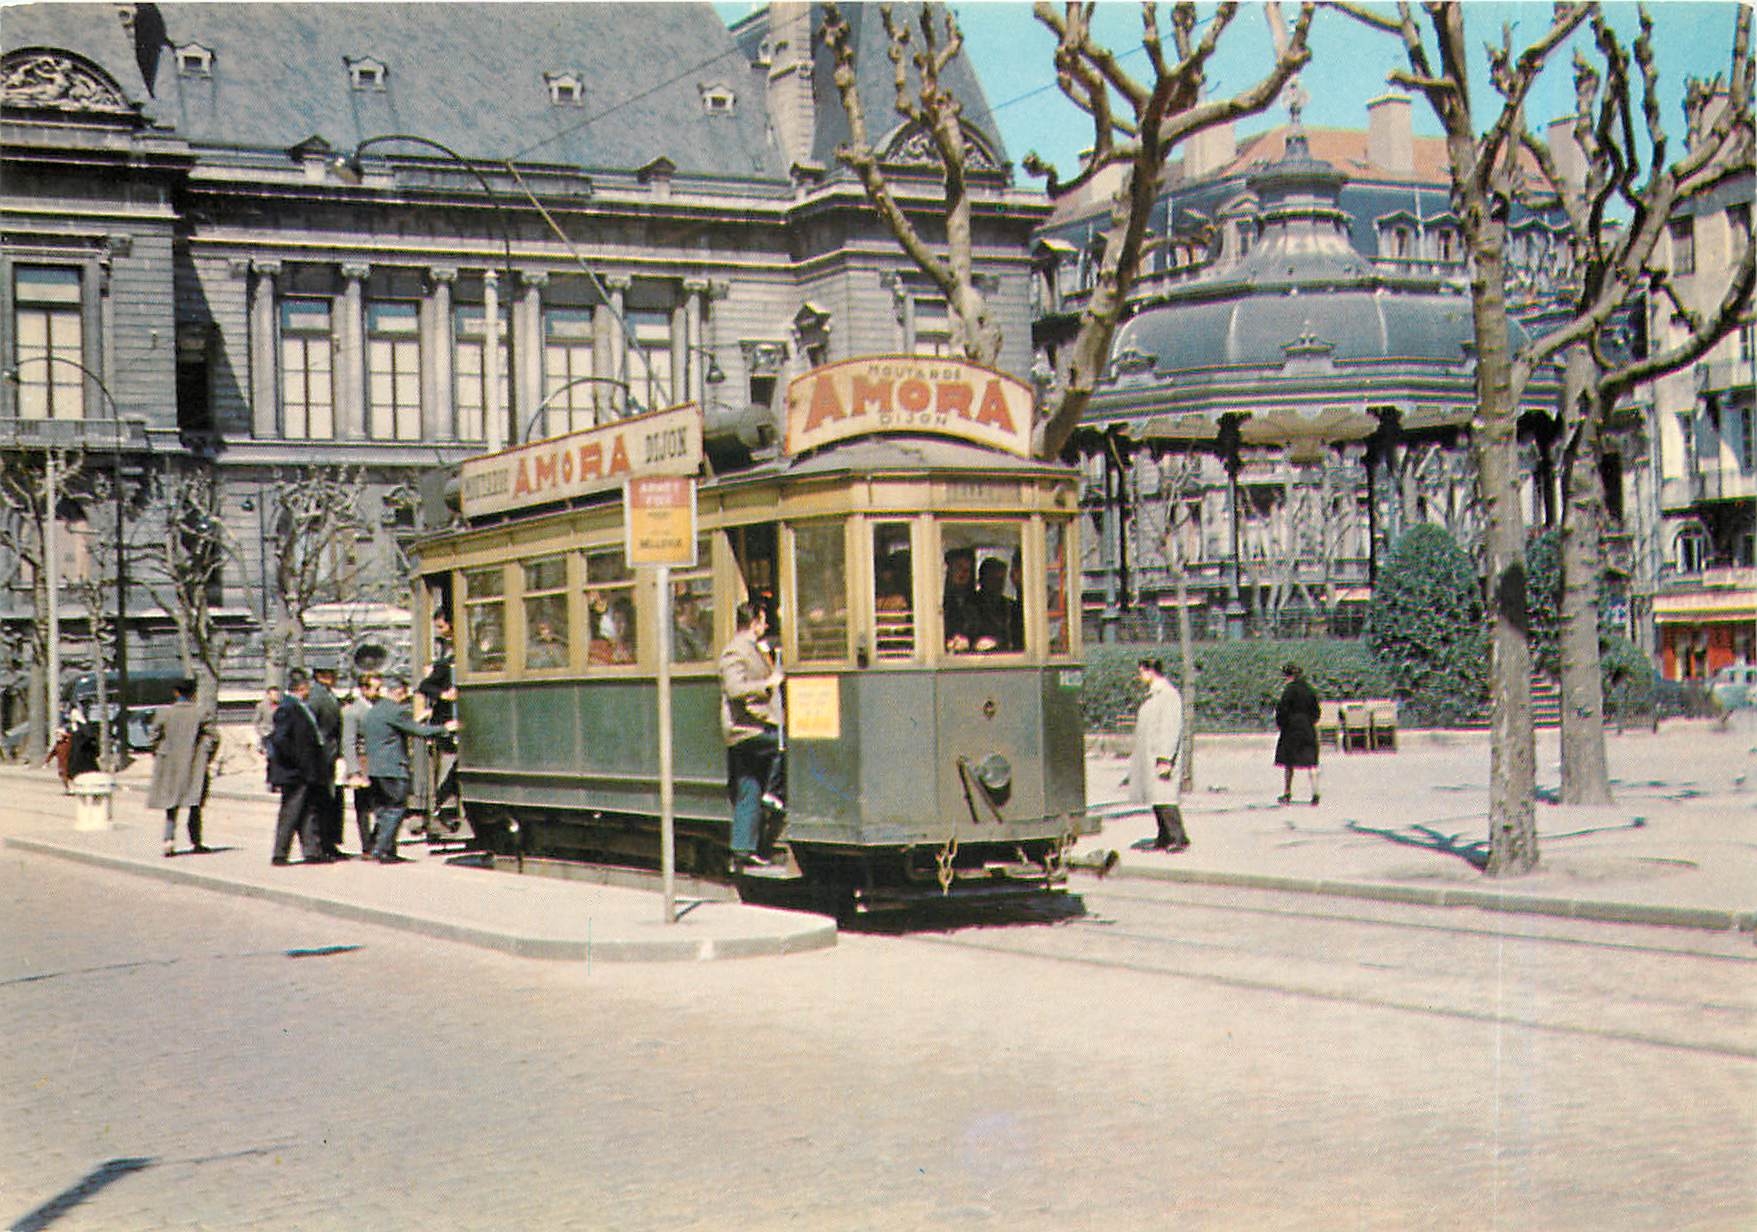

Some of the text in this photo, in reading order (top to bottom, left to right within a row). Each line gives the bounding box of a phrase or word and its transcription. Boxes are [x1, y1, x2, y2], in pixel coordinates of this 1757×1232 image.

[803, 374, 1017, 435] AMORA
[880, 412, 947, 426] DIJON
[513, 434, 631, 498] AMORA
[646, 426, 688, 464] DIJON
